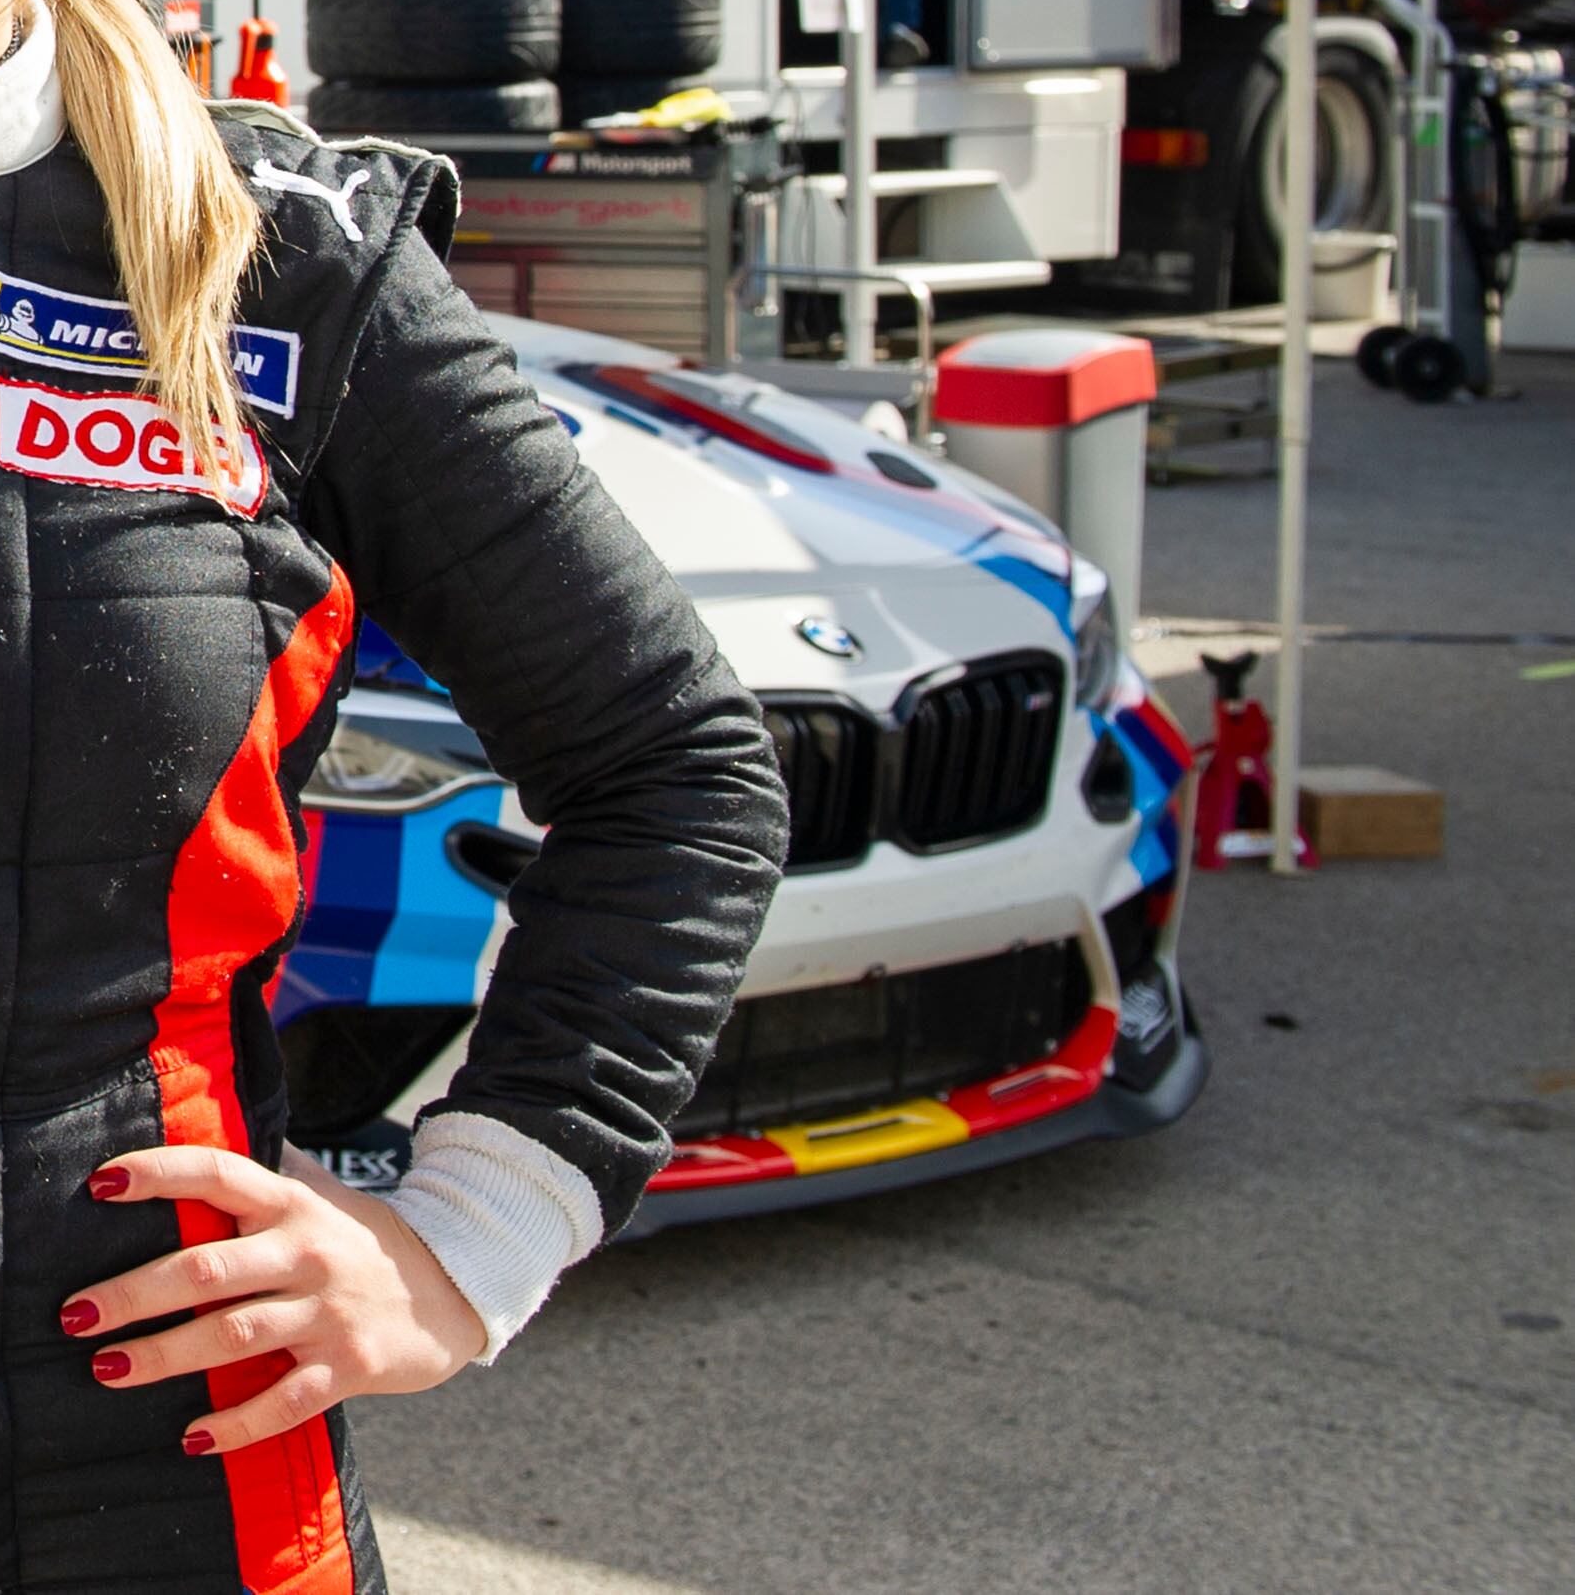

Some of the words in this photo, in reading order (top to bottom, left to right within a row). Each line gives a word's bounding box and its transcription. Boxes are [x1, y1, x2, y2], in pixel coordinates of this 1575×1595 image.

[581, 155, 692, 175] Motorsport
[48, 318, 265, 377] MICN
[305, 1148, 398, 1180] LESS
